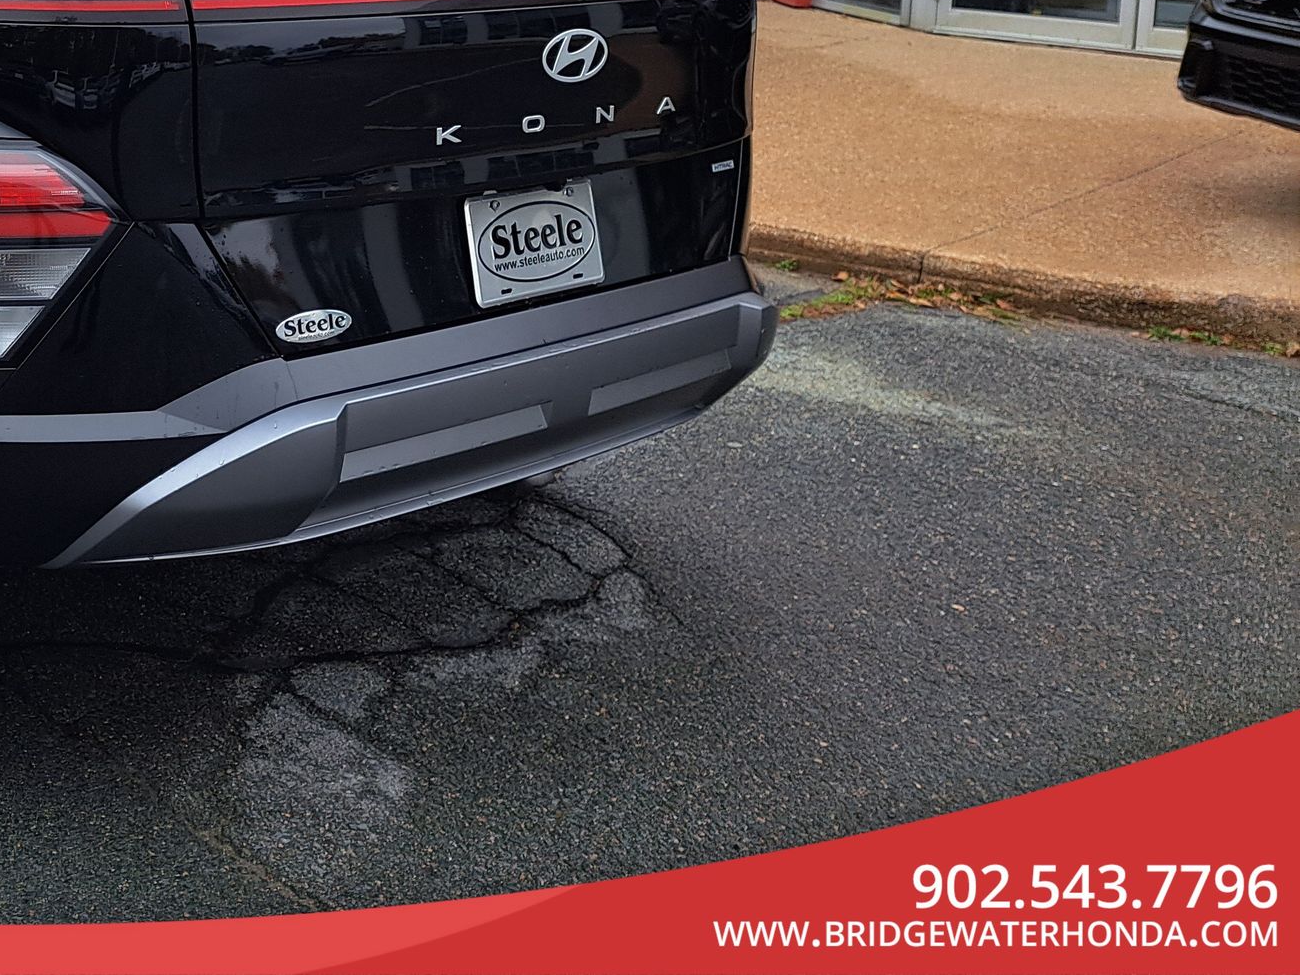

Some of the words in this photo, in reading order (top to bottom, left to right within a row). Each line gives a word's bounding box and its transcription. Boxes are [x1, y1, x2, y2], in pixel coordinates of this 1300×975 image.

[436, 96, 676, 146] KONA
[491, 214, 584, 260] Steele
[494, 246, 585, 272] www.steeleauto.com
[283, 313, 346, 337] Steele
